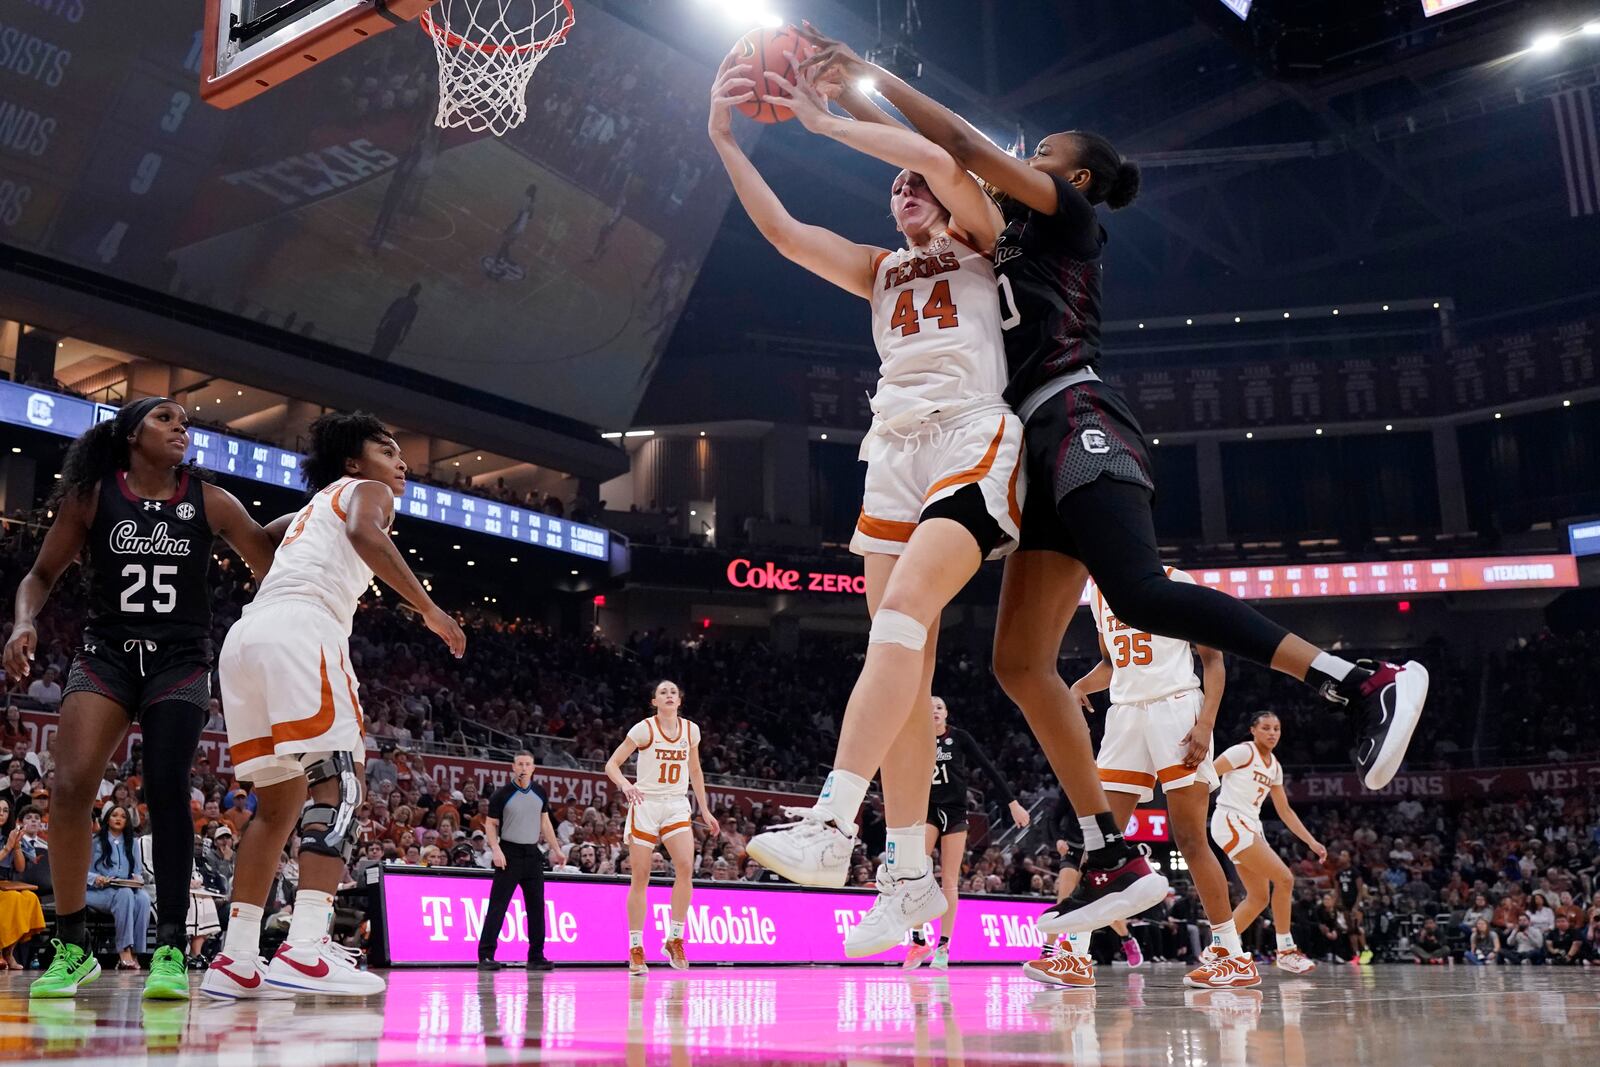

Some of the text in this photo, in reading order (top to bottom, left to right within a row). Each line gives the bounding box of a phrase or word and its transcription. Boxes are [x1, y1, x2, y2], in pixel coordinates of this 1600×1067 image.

[161, 91, 191, 133] 3
[130, 152, 162, 194] 9
[222, 138, 399, 204] TEXAS
[884, 251, 960, 290] TEXAS
[890, 279, 959, 337] 44
[228, 440, 238, 455] TO
[228, 458, 235, 472] 4
[284, 471, 290, 484] 2
[281, 504, 314, 547] 3
[440, 508, 446, 520] 1
[109, 519, 191, 557] Carolina
[120, 564, 178, 613] 25
[727, 558, 866, 594] Coke ZERO
[1113, 633, 1153, 668] 35
[654, 748, 686, 760] TEXAS
[433, 764, 464, 793] OF
[474, 768, 513, 794] TH
[658, 762, 681, 784] 10
[932, 763, 948, 784] 21
[1148, 815, 1166, 836] T
[421, 896, 578, 943] T Moble
[686, 904, 776, 945] Mobile
[980, 914, 1000, 947] T
